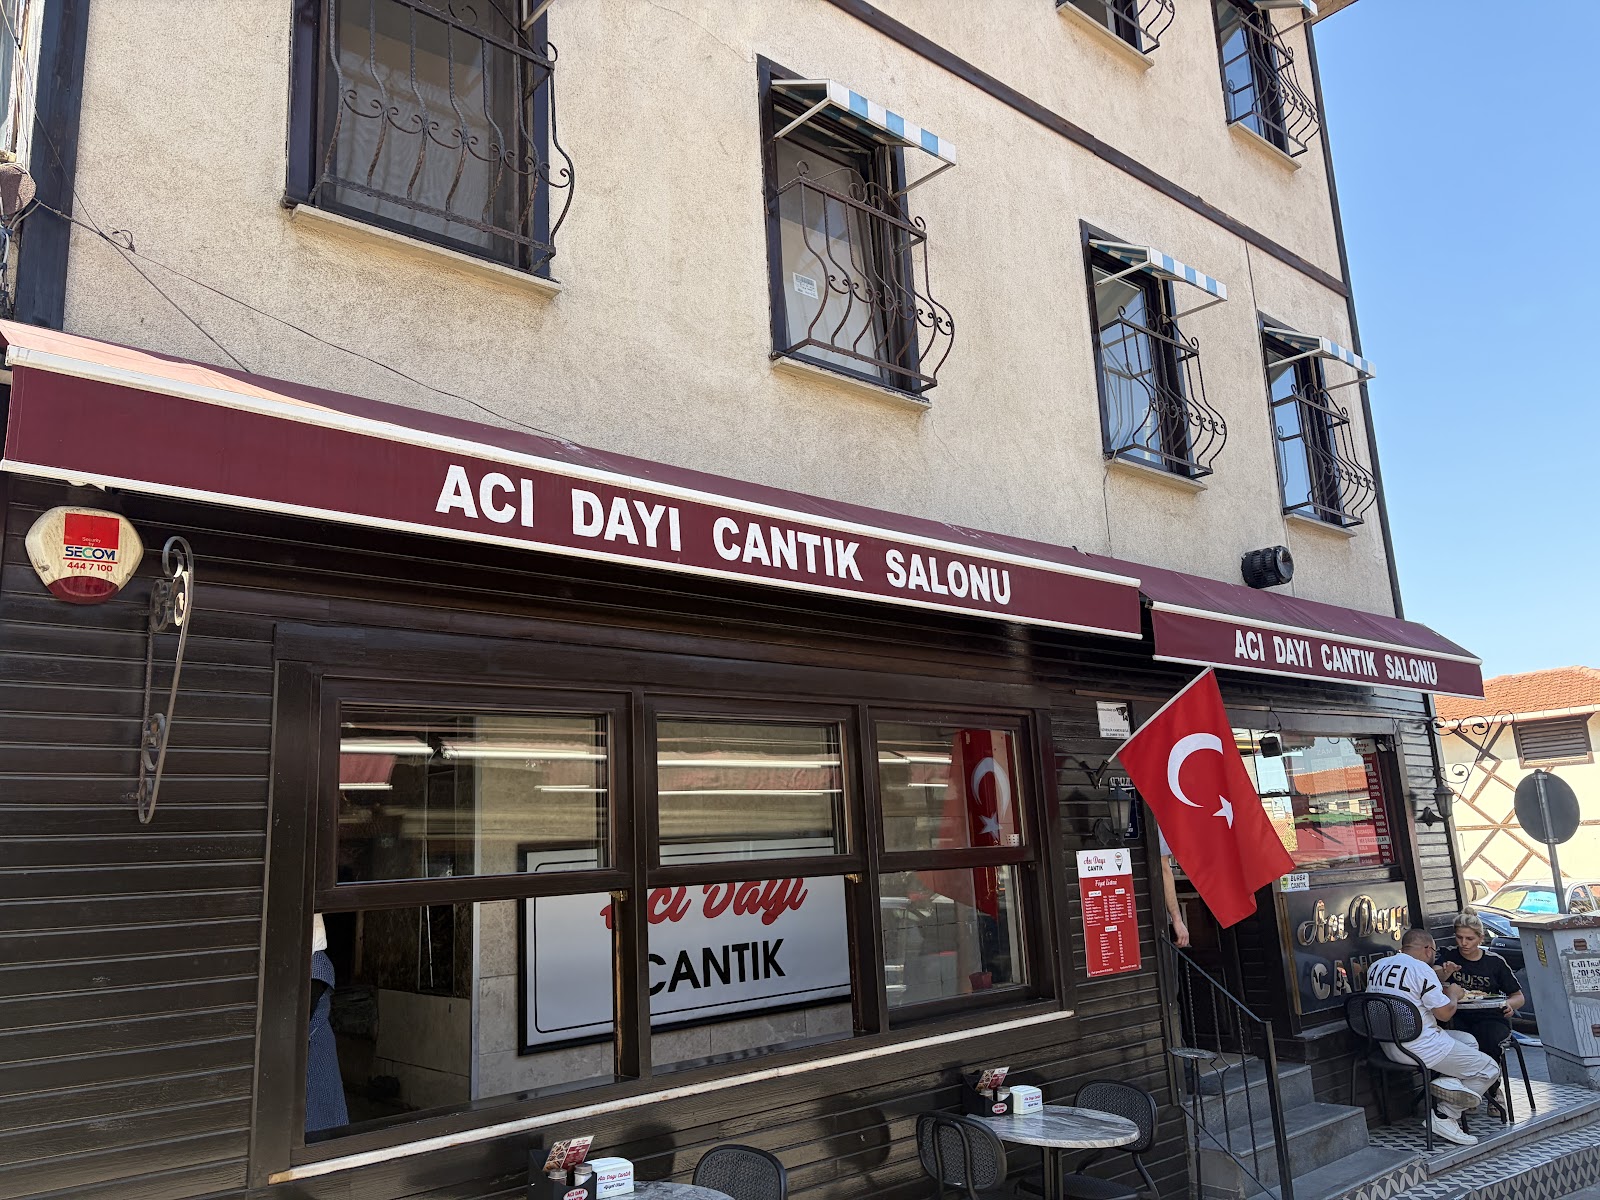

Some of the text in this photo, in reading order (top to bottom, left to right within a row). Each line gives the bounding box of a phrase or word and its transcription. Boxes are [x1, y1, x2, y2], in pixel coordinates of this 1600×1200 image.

[435, 464, 1011, 605] ACI DAYI CANTIK SALONU
[65, 546, 116, 561] SECOM
[67, 562, 86, 570] 444
[97, 564, 113, 572] 100
[1234, 629, 1438, 686] ACI DAYI CANTIK SALONU
[648, 938, 786, 996] CANTIK
[1453, 971, 1491, 988] GUESS
